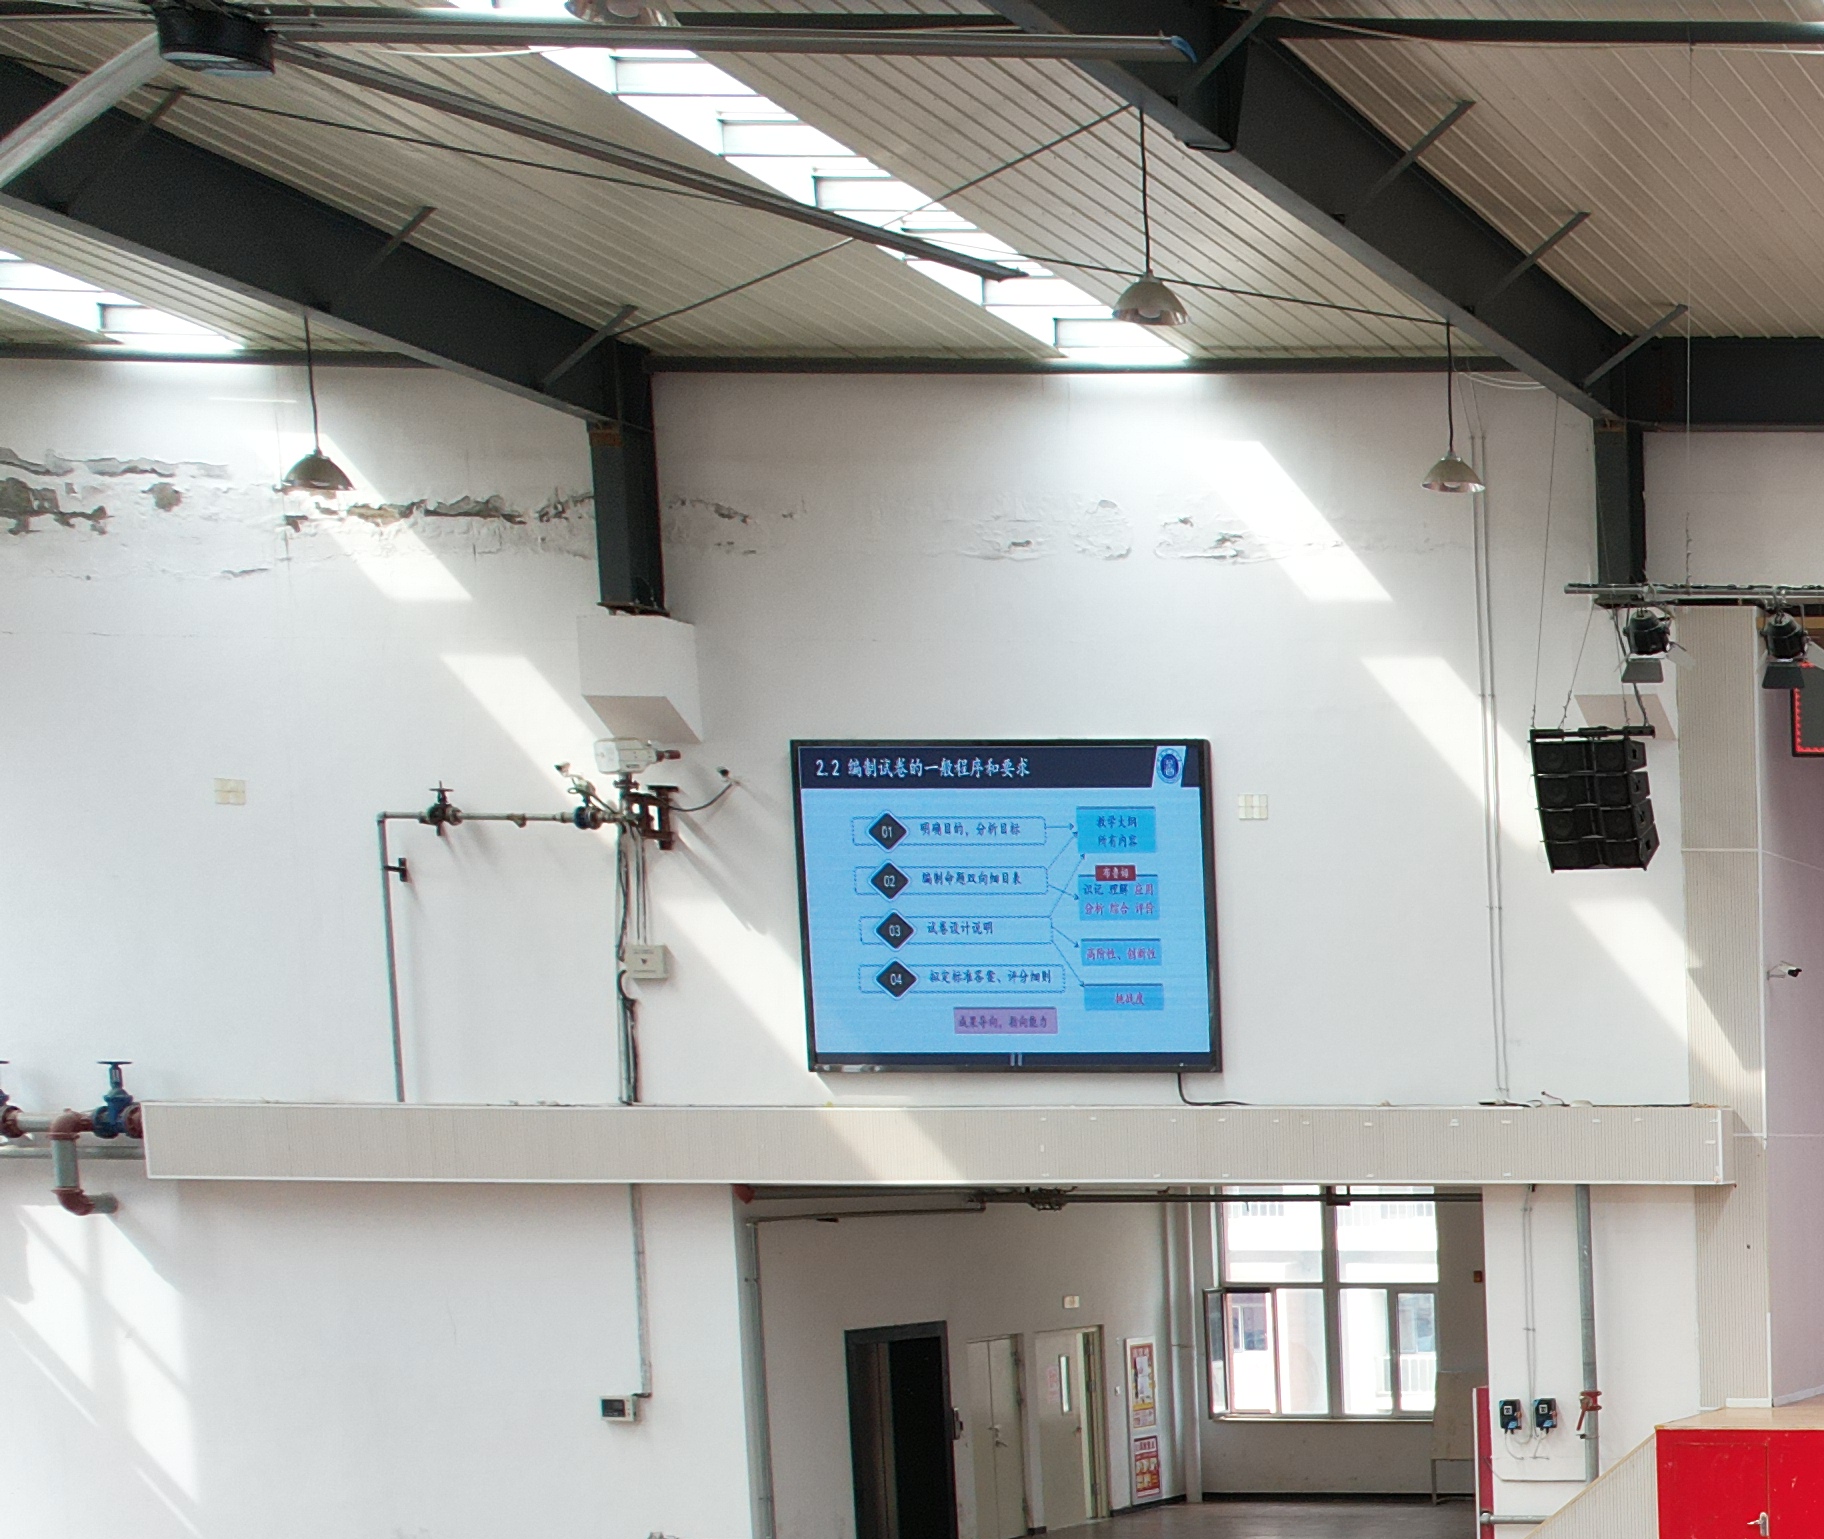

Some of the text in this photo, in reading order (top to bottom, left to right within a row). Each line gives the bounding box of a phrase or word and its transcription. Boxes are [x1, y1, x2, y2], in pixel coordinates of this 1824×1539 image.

[816, 757, 1030, 778] 2.2 编制试卷的一般程序和要求
[881, 825, 893, 838] 01
[883, 875, 896, 887] 02
[888, 925, 901, 937] 03
[890, 973, 902, 986] 04
